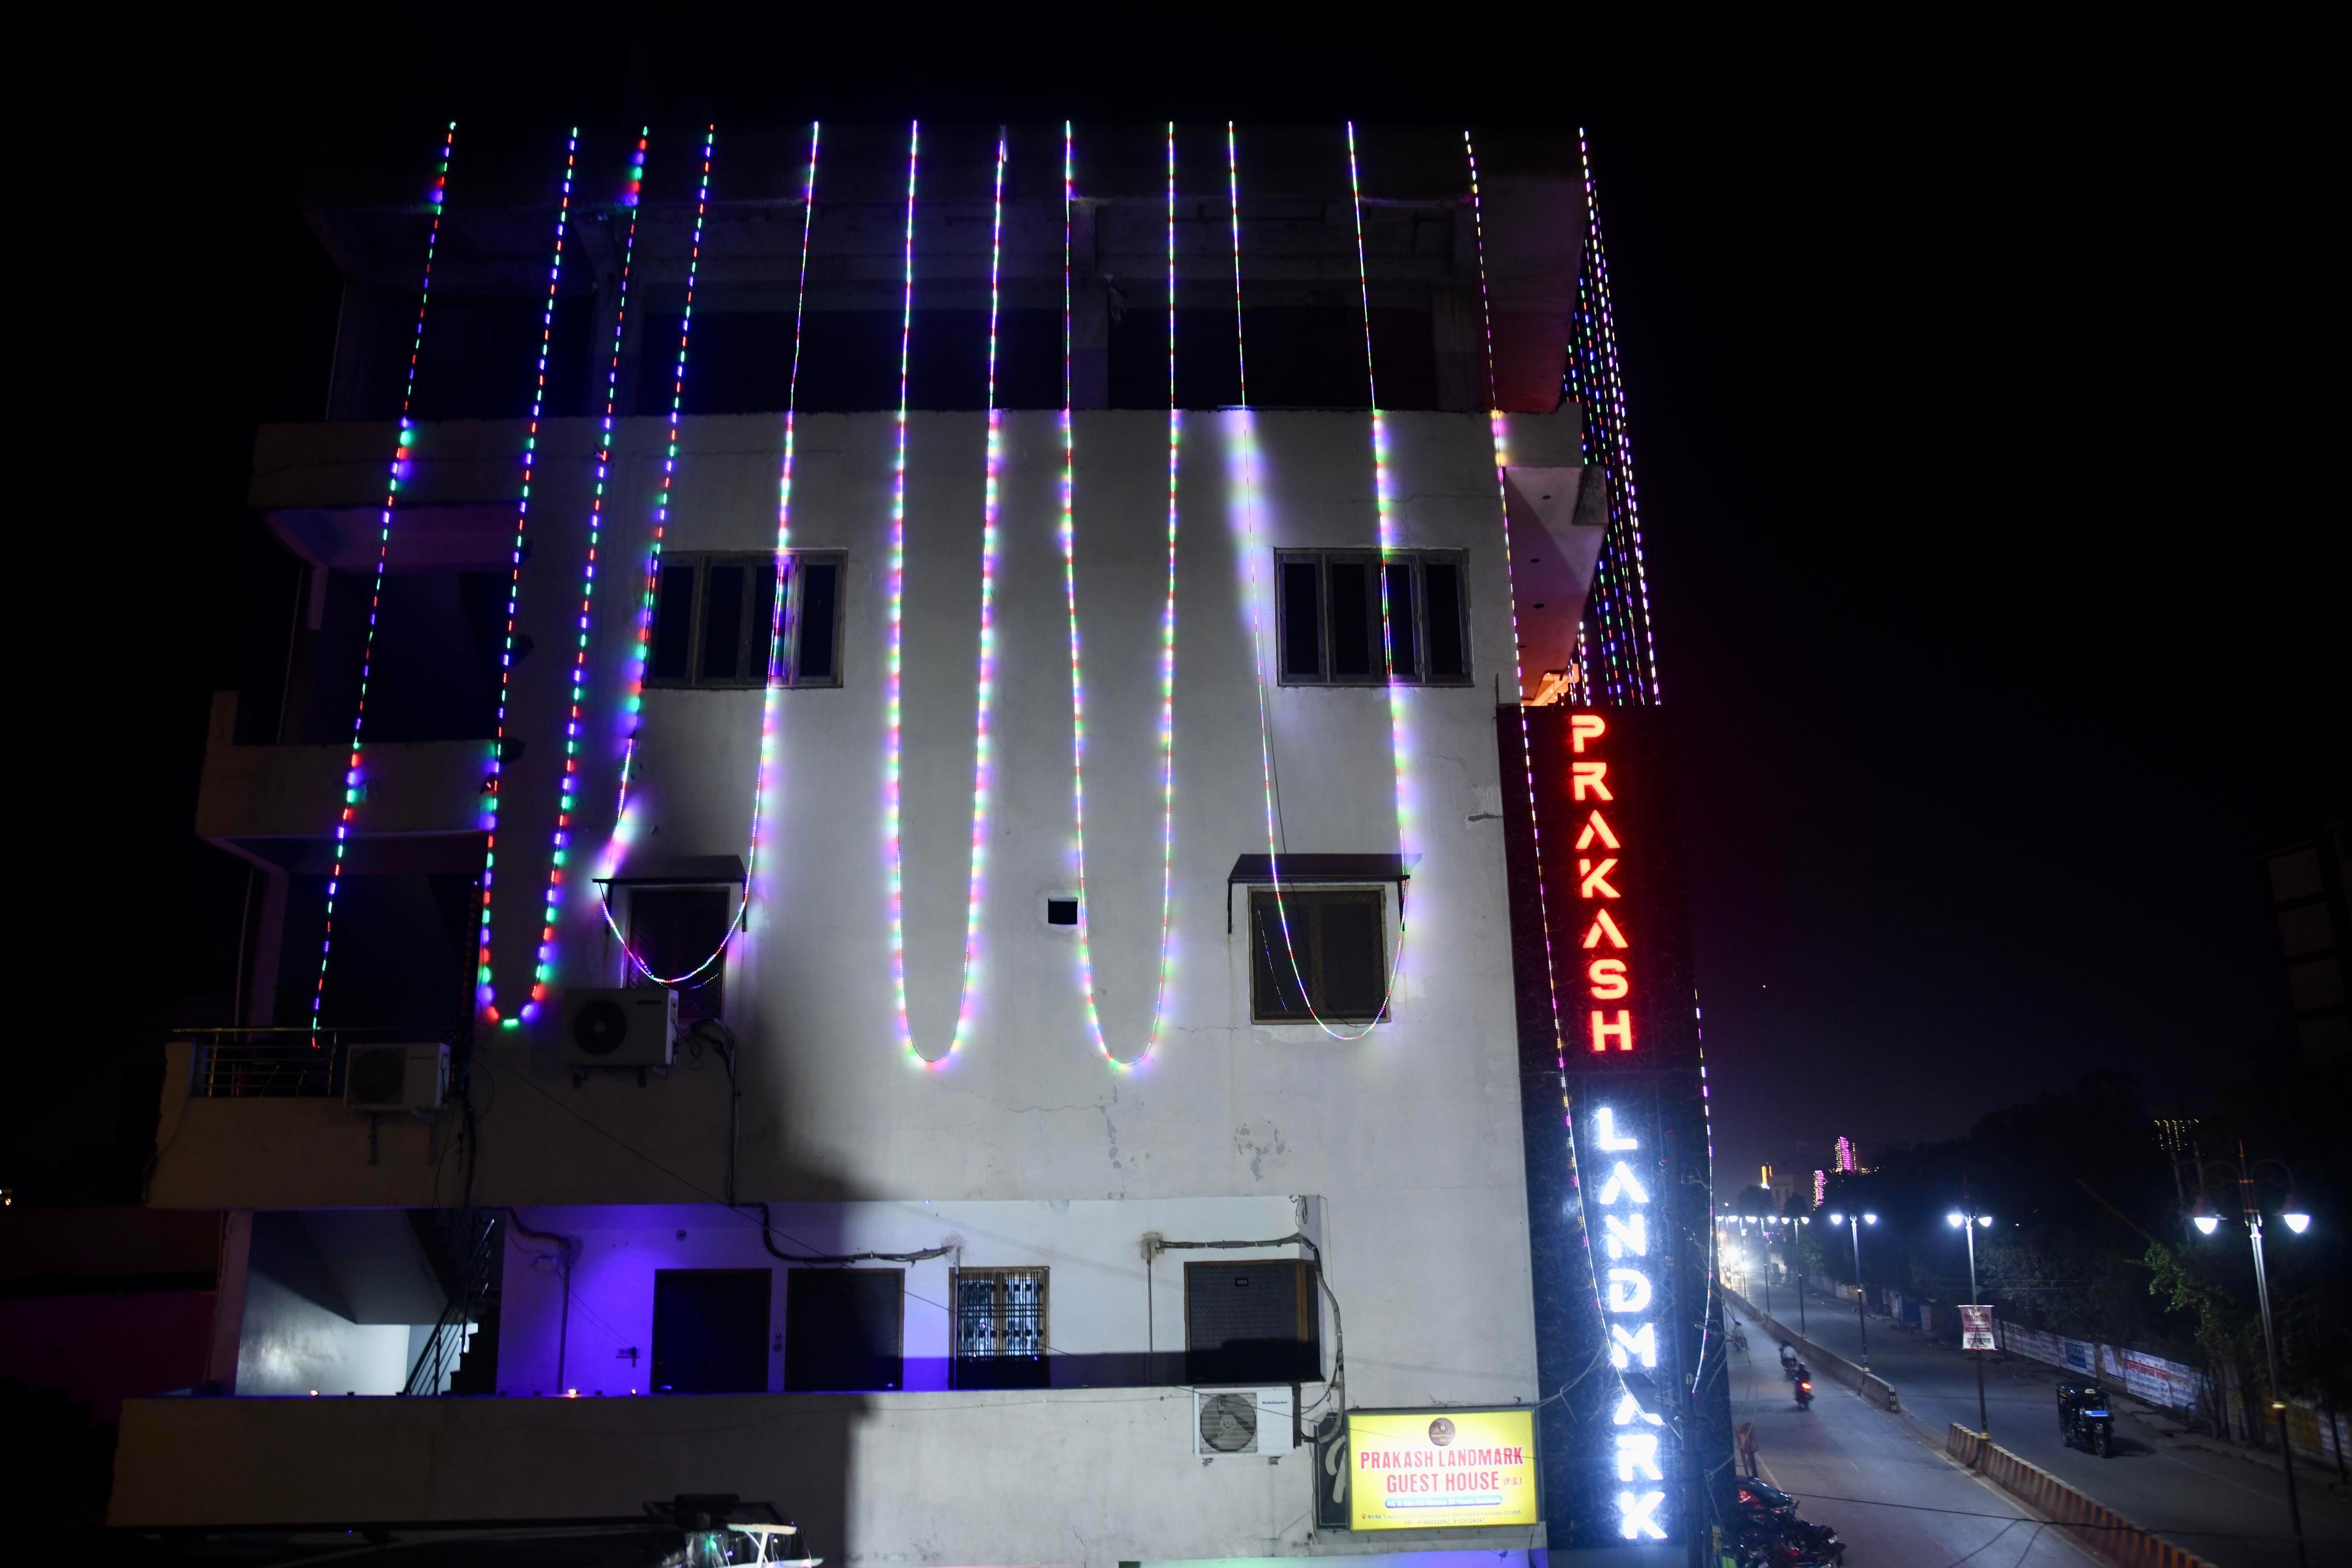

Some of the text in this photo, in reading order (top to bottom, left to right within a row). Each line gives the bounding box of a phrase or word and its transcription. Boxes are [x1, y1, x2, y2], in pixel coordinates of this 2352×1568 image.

[1570, 714, 1633, 1052] PRAKASH
[1361, 1447, 1523, 1469] PRAKASH LANDMARK
[1387, 1471, 1522, 1493] GUEST HOUSE (P.G.)
